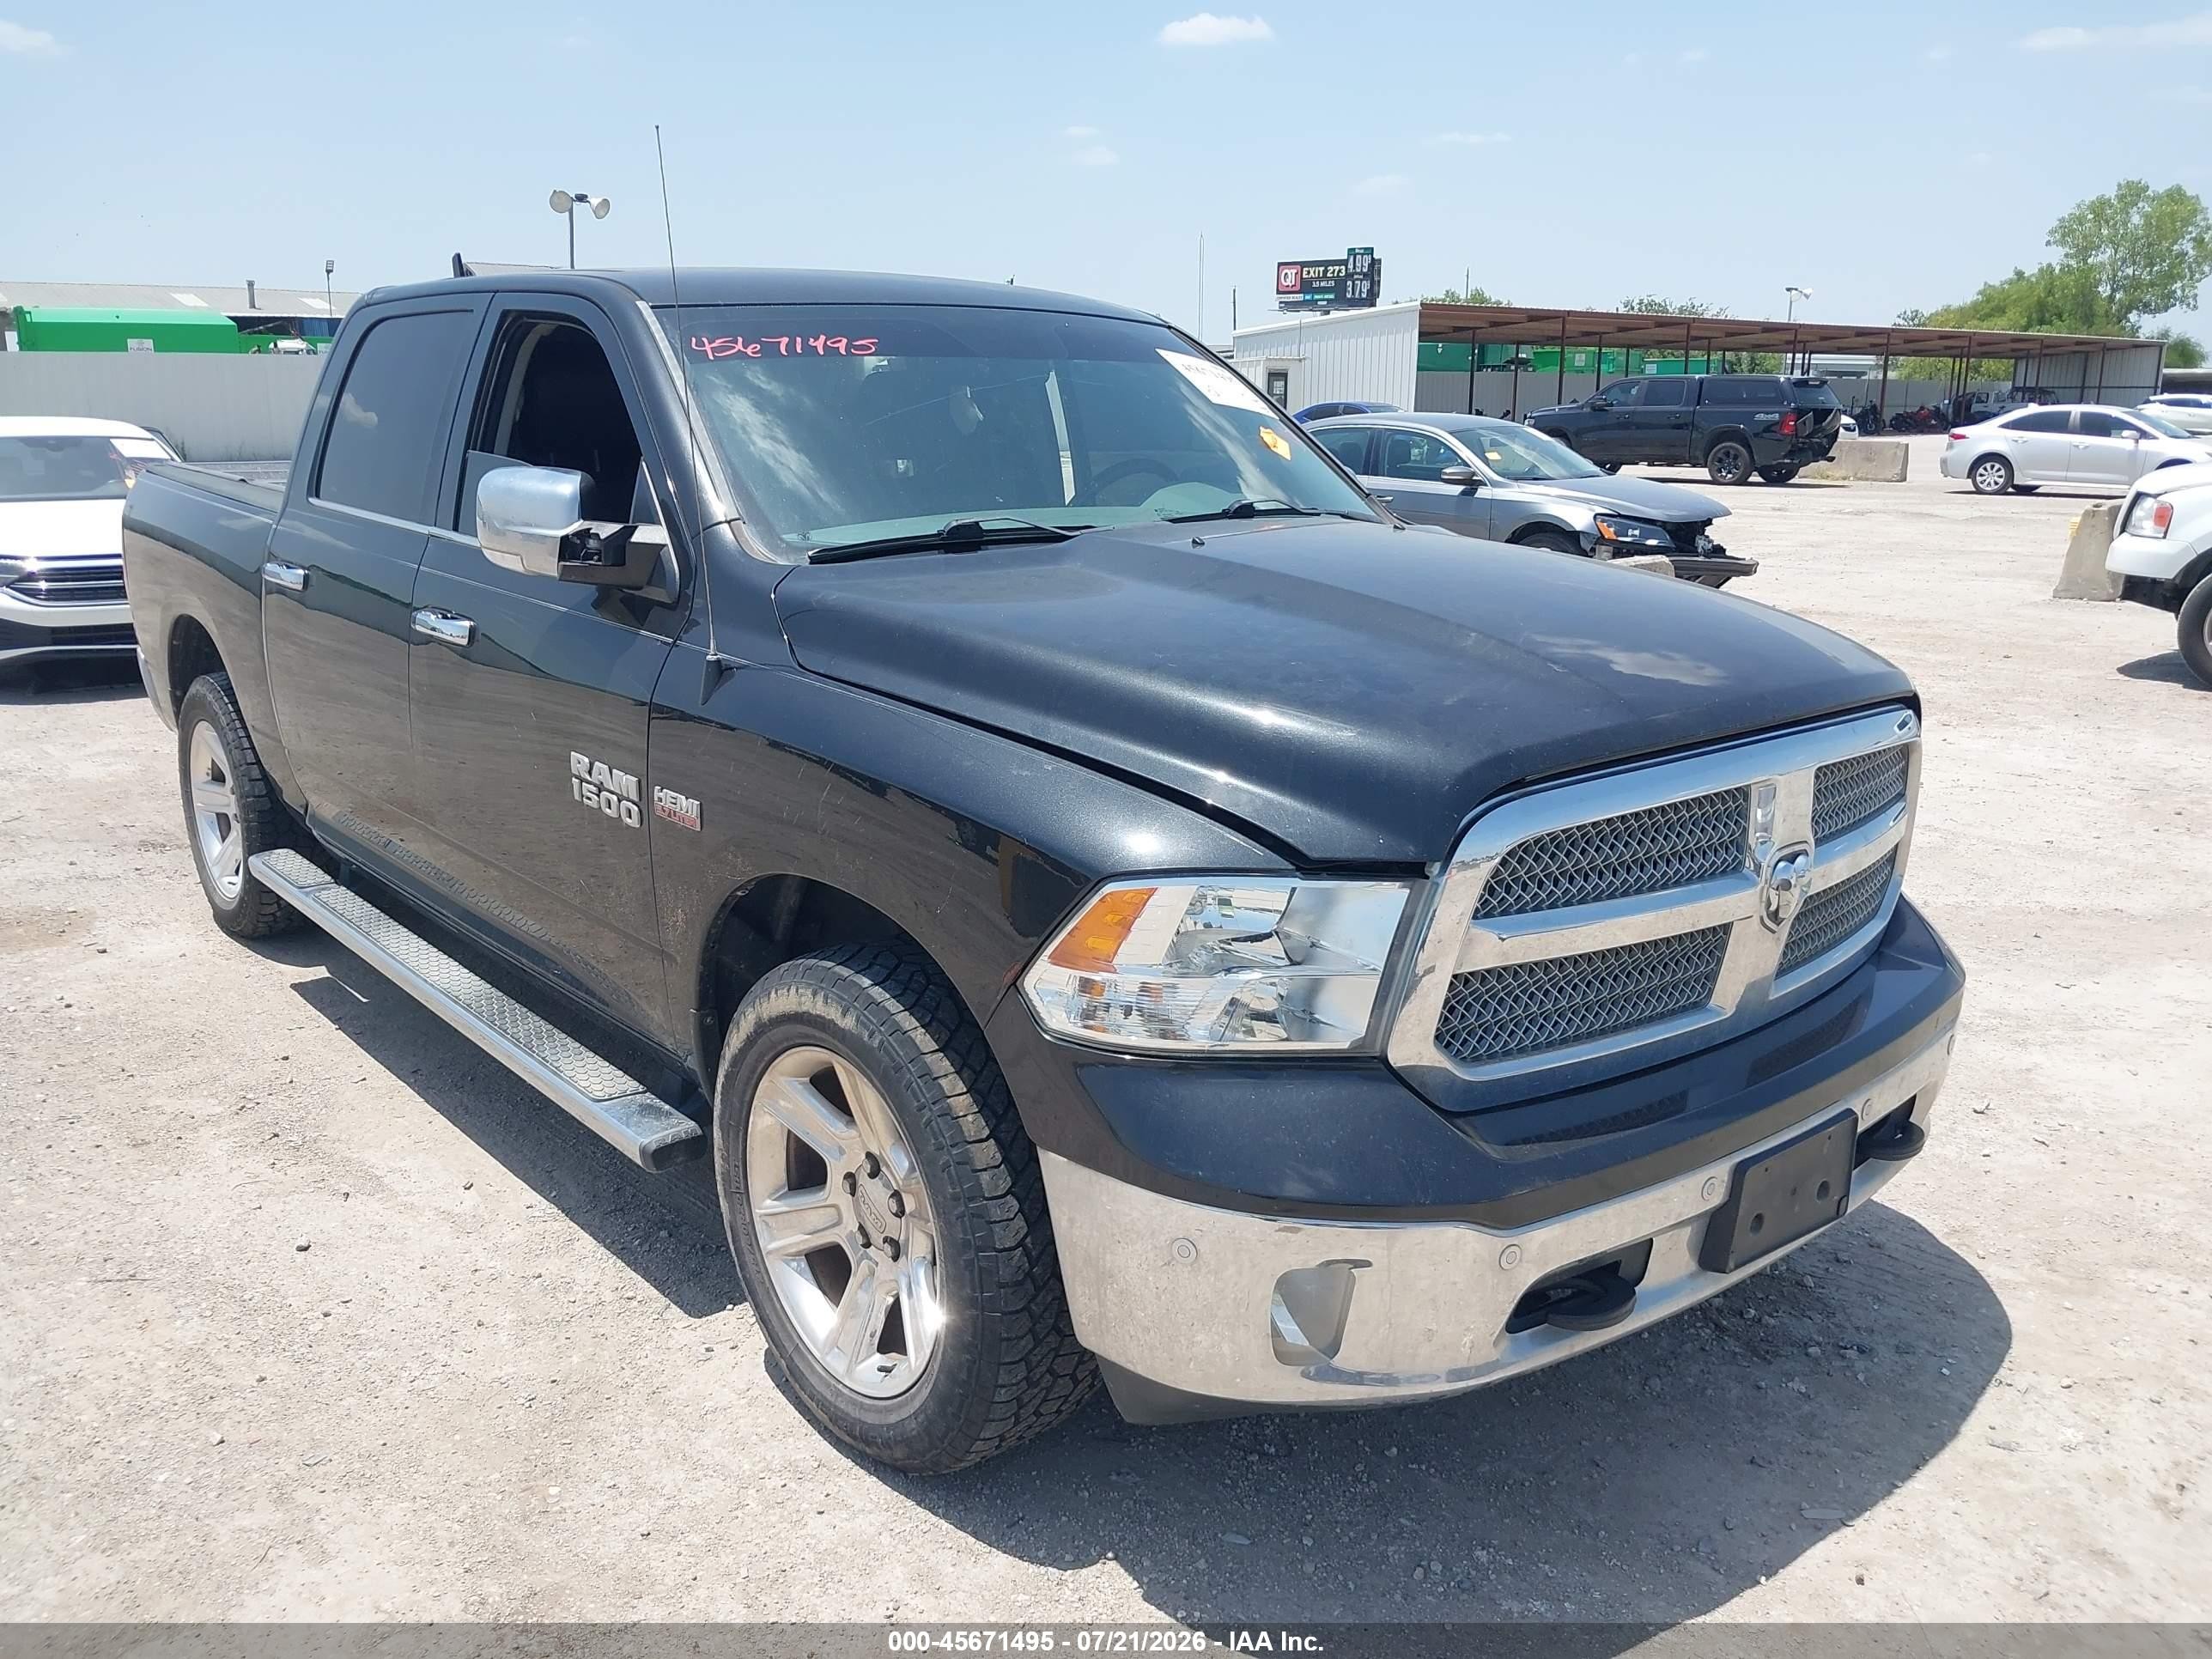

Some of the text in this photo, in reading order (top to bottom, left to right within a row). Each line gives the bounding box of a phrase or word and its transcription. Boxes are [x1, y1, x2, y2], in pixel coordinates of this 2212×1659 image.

[1280, 269, 1297, 288] QT
[1302, 267, 1325, 278] EXIT
[1327, 265, 1346, 277] 273
[691, 335, 878, 360] 45671495
[570, 750, 641, 802] RAM
[571, 776, 641, 828] 1500
[653, 786, 701, 817] HEMI
